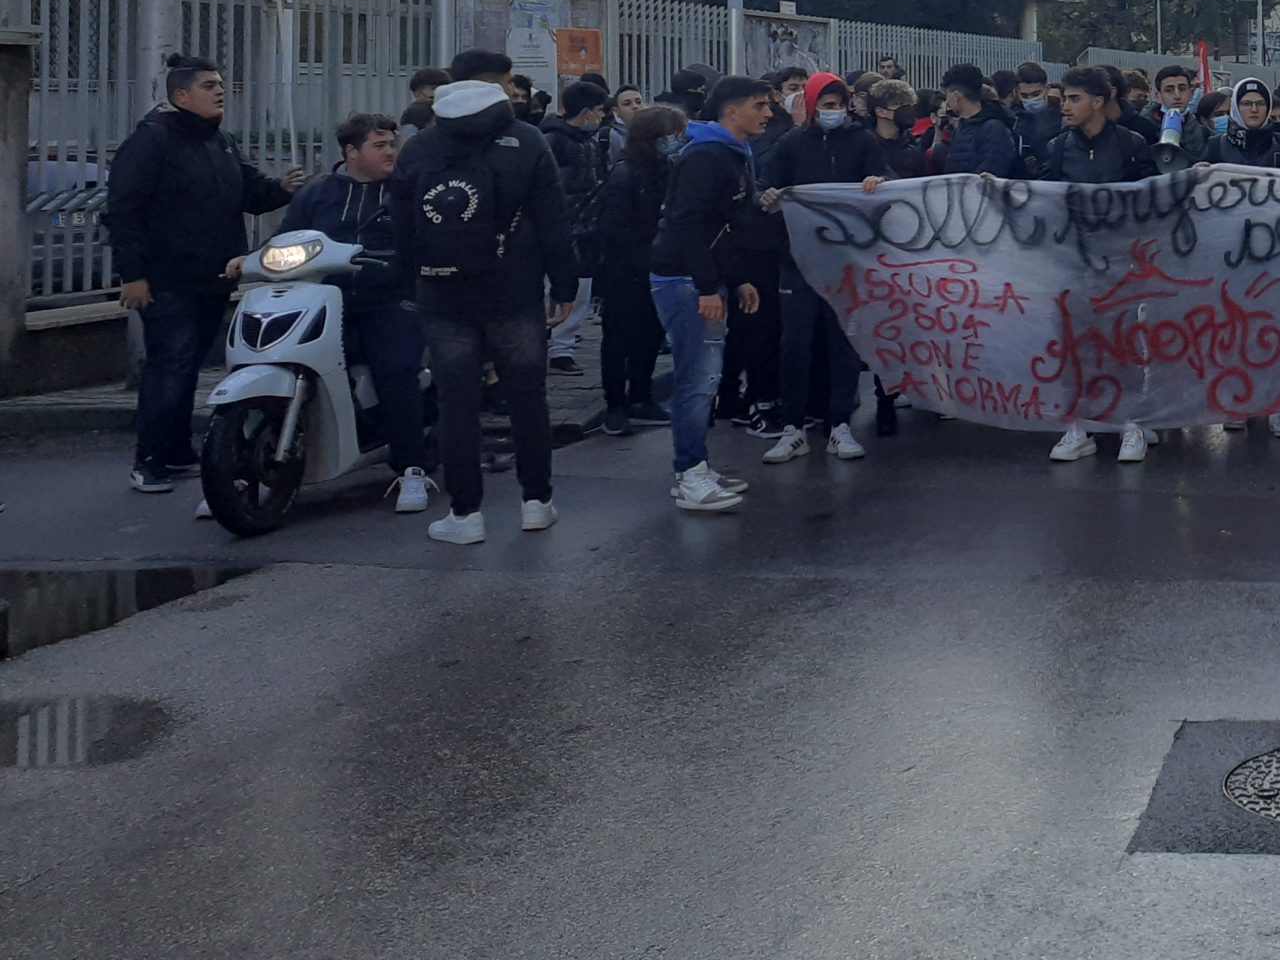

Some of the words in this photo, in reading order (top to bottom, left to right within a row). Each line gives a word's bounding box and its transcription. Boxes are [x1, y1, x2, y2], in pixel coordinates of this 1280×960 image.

[423, 183, 446, 200] THE
[448, 179, 477, 196] WALL
[423, 204, 442, 224] OFF
